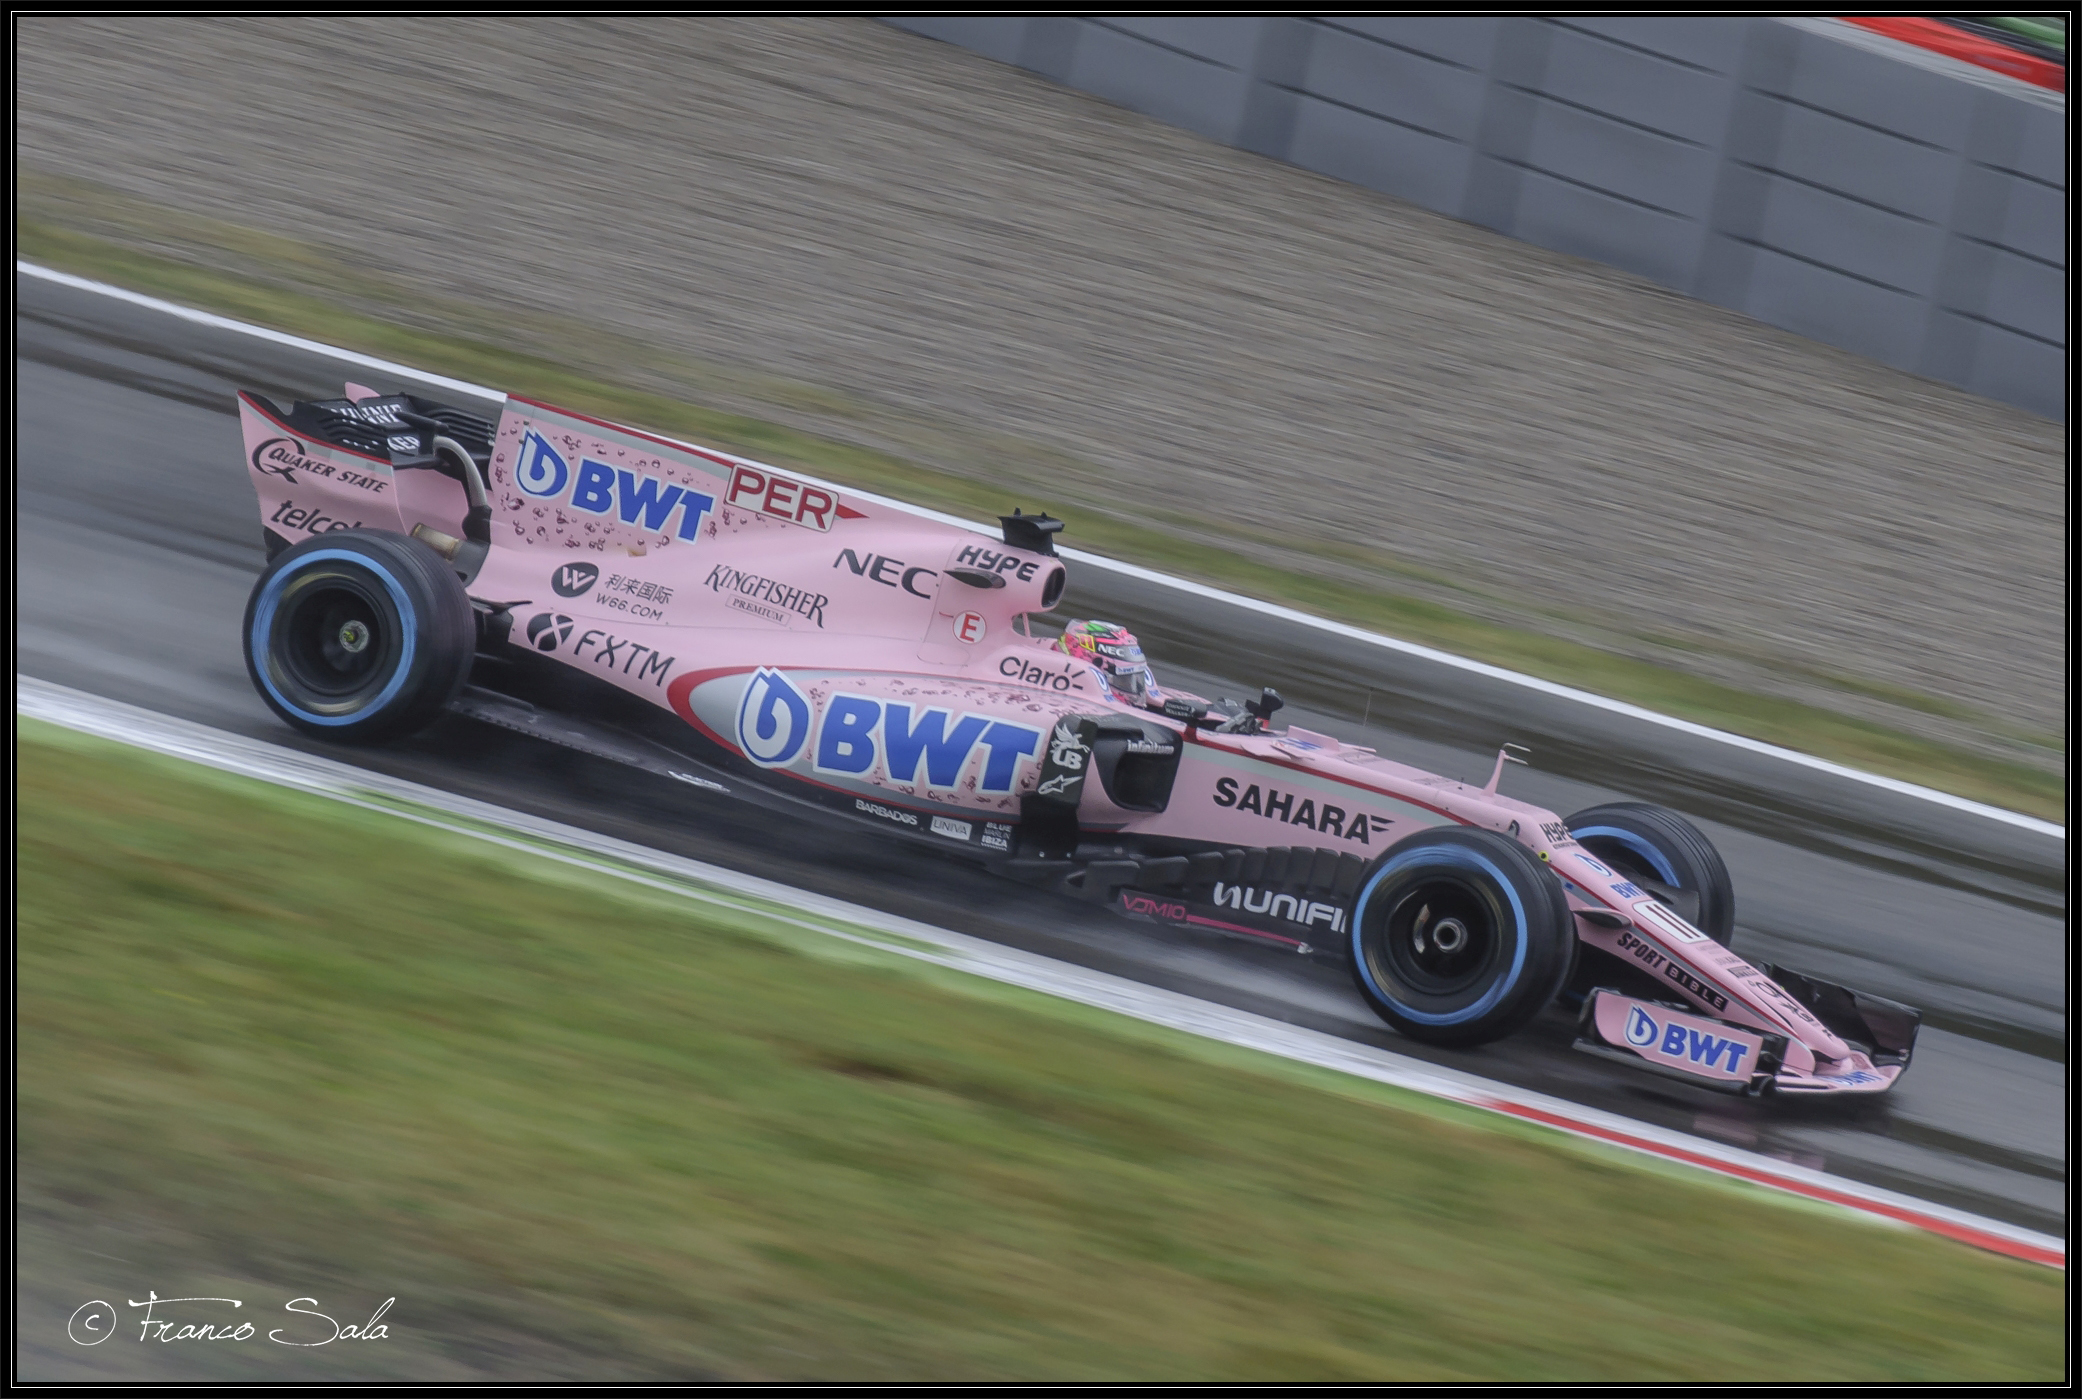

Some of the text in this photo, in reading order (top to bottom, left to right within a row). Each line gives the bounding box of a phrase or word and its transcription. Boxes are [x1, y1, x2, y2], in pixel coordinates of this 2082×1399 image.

[268, 447, 389, 494] QUAKER STATE
[270, 500, 363, 535] telce
[569, 456, 716, 543] BWT
[728, 466, 833, 530] PER
[832, 547, 939, 600] NEC
[956, 544, 1041, 583] HYPE
[595, 592, 664, 621] W66.COM
[604, 573, 675, 605] 利来国际
[703, 563, 829, 629] KINGFISHER
[732, 597, 785, 623] PREMIUM
[959, 613, 981, 643] E
[573, 629, 677, 687] FXTM
[1097, 643, 1125, 657] NEC
[999, 656, 1070, 691] Claro
[815, 694, 1042, 793] BWT
[855, 798, 918, 826] BARBADOS
[932, 818, 968, 836] UNIVA
[1212, 776, 1370, 845] SAHARA
[1617, 932, 1725, 1009] SPORT BIBLE
[1660, 1022, 1749, 1075] BWT
